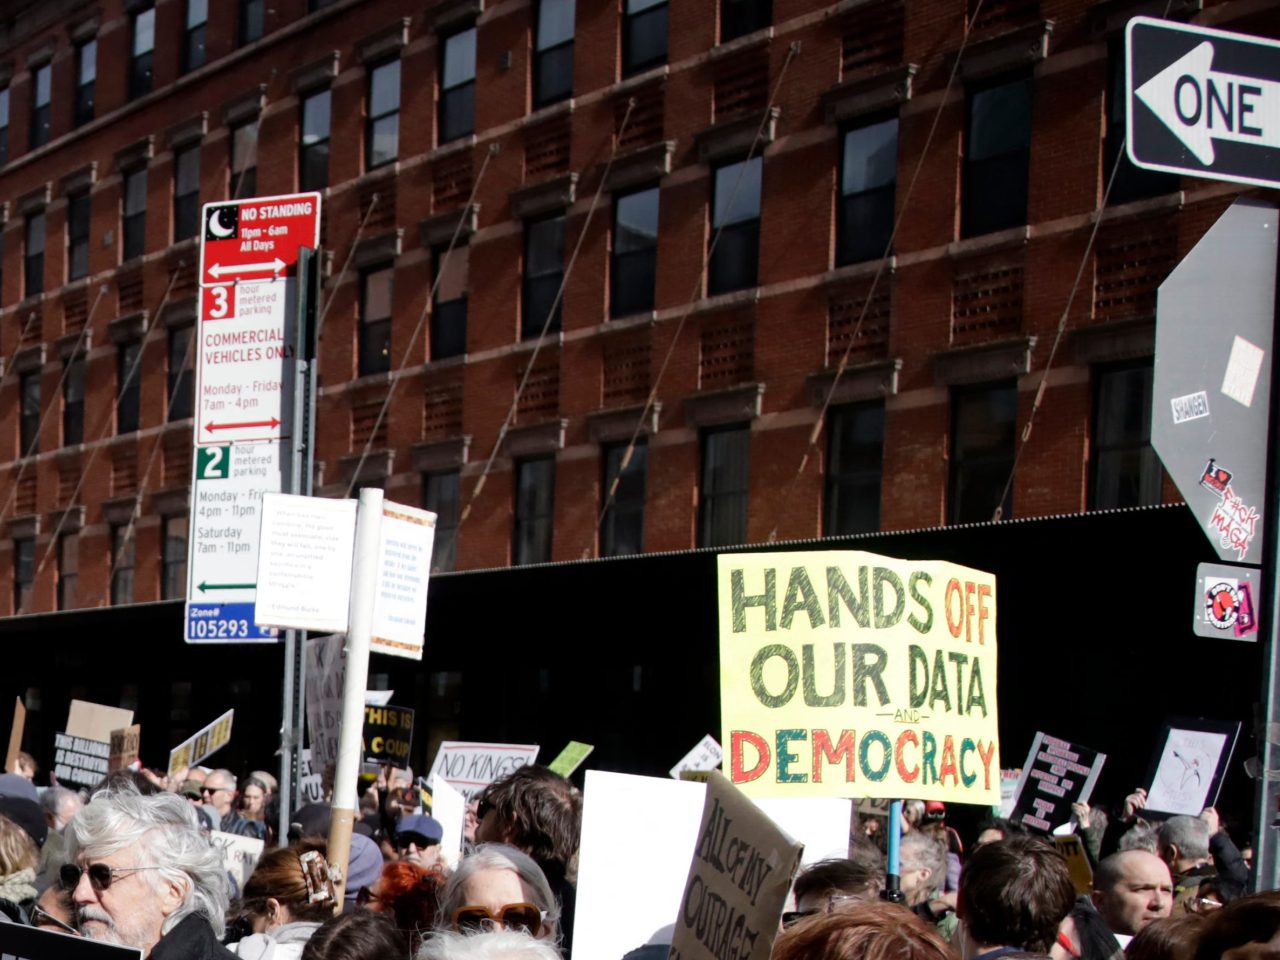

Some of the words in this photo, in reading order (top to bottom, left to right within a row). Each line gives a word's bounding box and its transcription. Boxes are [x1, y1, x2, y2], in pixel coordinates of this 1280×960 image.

[1174, 73, 1263, 137] ONE
[241, 206, 257, 221] NO
[260, 202, 312, 220] STANDING
[268, 224, 288, 236] 6am
[240, 241, 252, 252] All
[254, 239, 275, 253] Days
[240, 284, 260, 295] hour
[209, 286, 228, 318] 3
[239, 292, 277, 306] metered
[238, 304, 272, 318] parking
[205, 328, 284, 348] COMMERCIAL
[205, 348, 262, 365] VEHICLES
[266, 345, 296, 360] ONLY
[204, 382, 242, 397] Monday
[253, 380, 284, 394] Friday
[204, 397, 225, 410] 7am
[235, 397, 259, 410] 4pm
[234, 444, 255, 455] hour
[203, 446, 223, 478] 2
[234, 454, 272, 466] metered
[233, 466, 267, 478] parking
[199, 490, 238, 504] Monday
[199, 504, 220, 517] 4pm
[197, 527, 242, 540] Saturday
[197, 541, 218, 553] 7am
[190, 607, 219, 618] Zone#
[730, 565, 935, 635] HANDS
[944, 577, 993, 646] OFF
[190, 619, 249, 638] 105293
[750, 641, 891, 709] OUR
[908, 644, 988, 719] DATA
[893, 708, 921, 723] AND
[371, 736, 410, 758] COUP
[64, 751, 110, 773] DESTROYIN
[438, 753, 465, 778] NO
[730, 728, 996, 791] DEMOCRACY
[695, 797, 732, 874] ALL
[738, 847, 774, 907] MY
